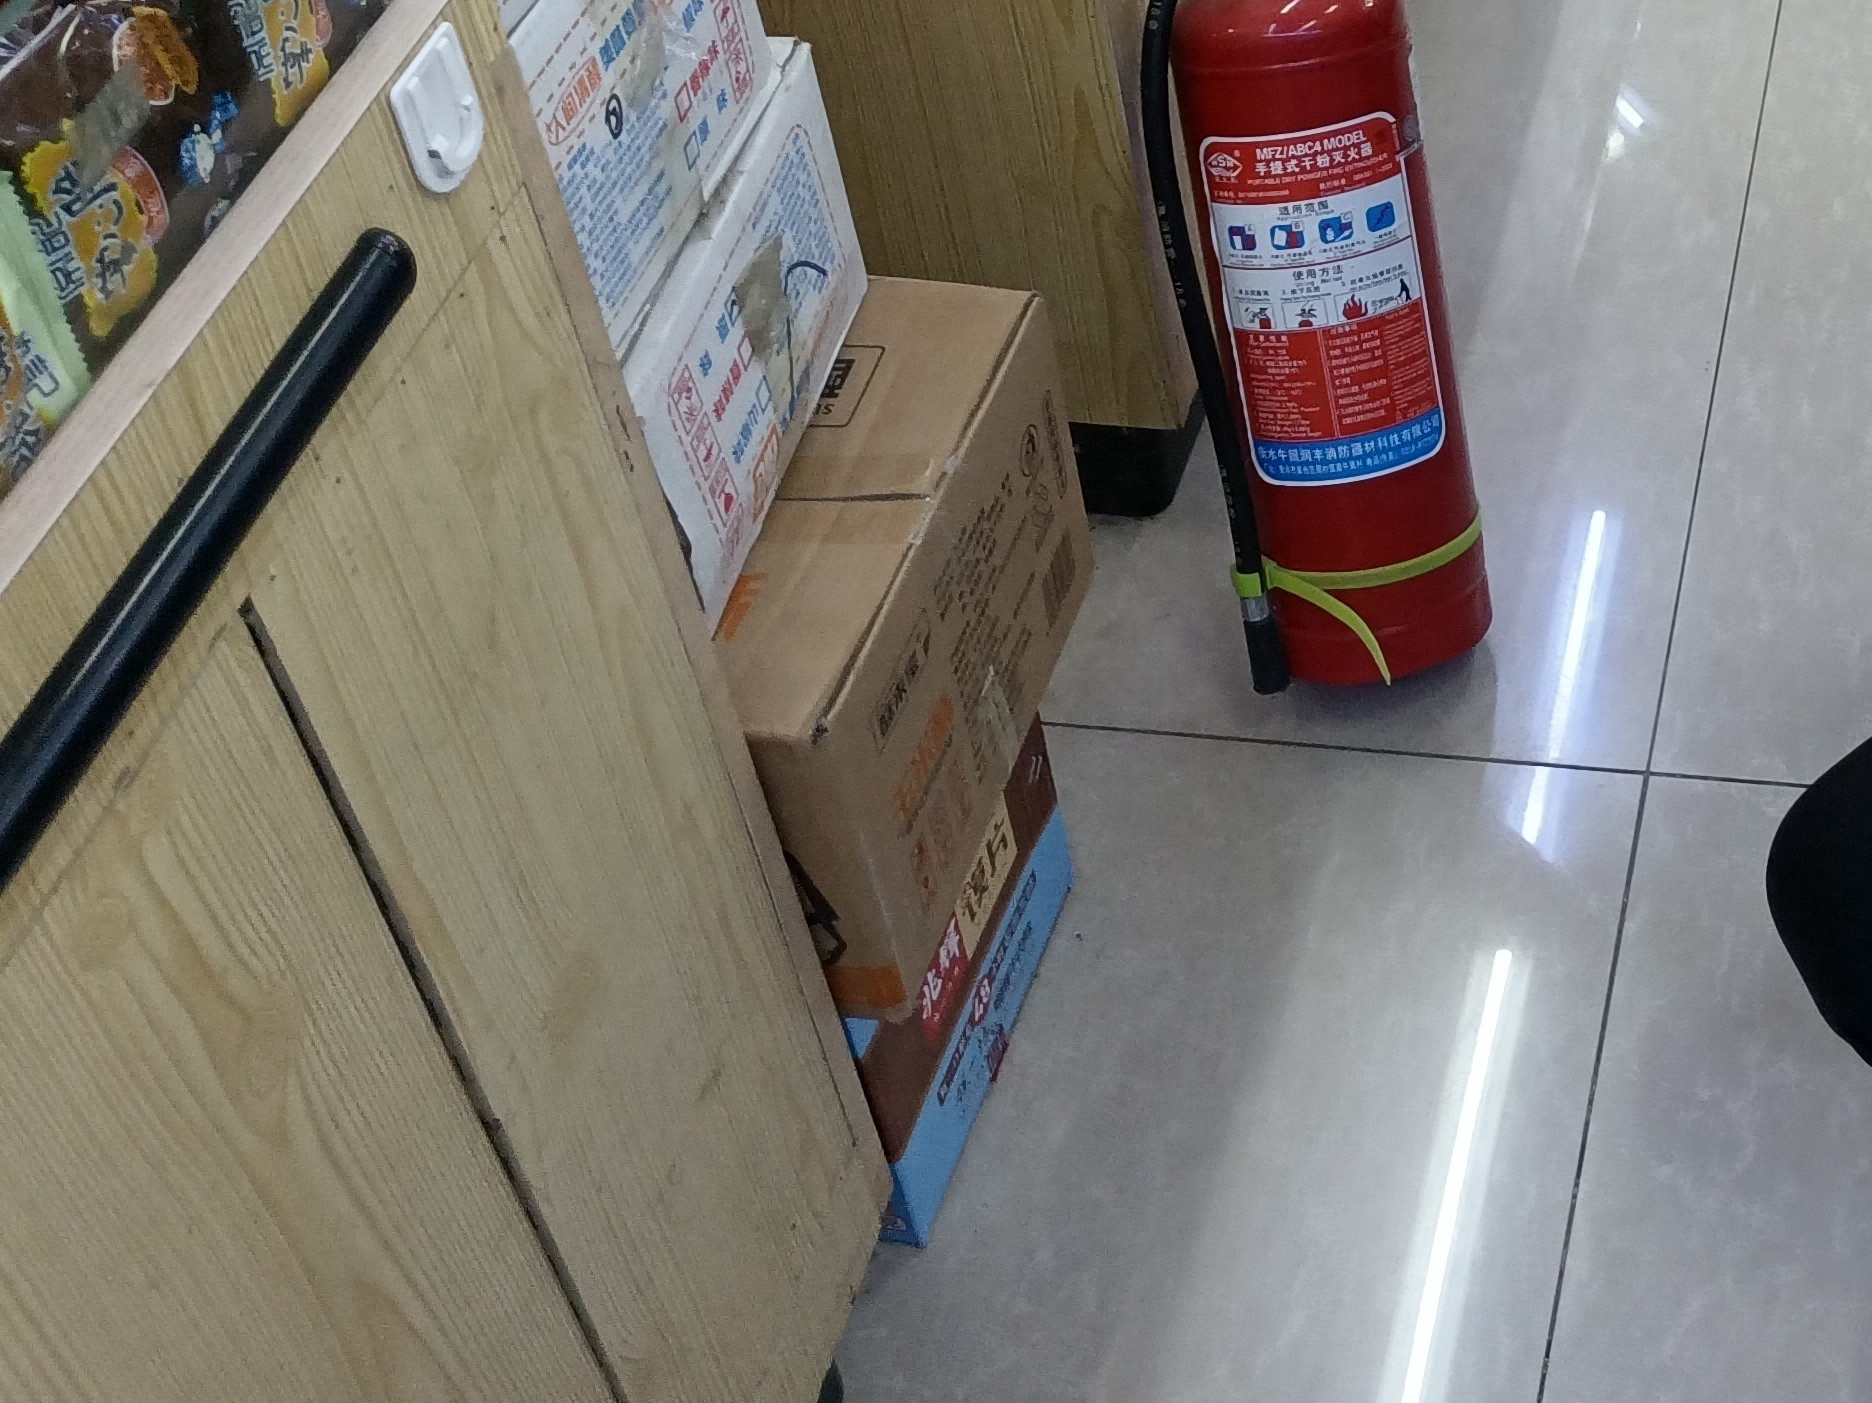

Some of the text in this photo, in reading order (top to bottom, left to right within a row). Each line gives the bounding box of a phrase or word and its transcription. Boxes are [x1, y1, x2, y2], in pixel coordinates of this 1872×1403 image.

[1324, 129, 1367, 151] MODEL
[1254, 142, 1374, 176] 手提式干粉灭火器
[1278, 199, 1329, 217] 适用范围
[1291, 264, 1345, 282] 使用方法
